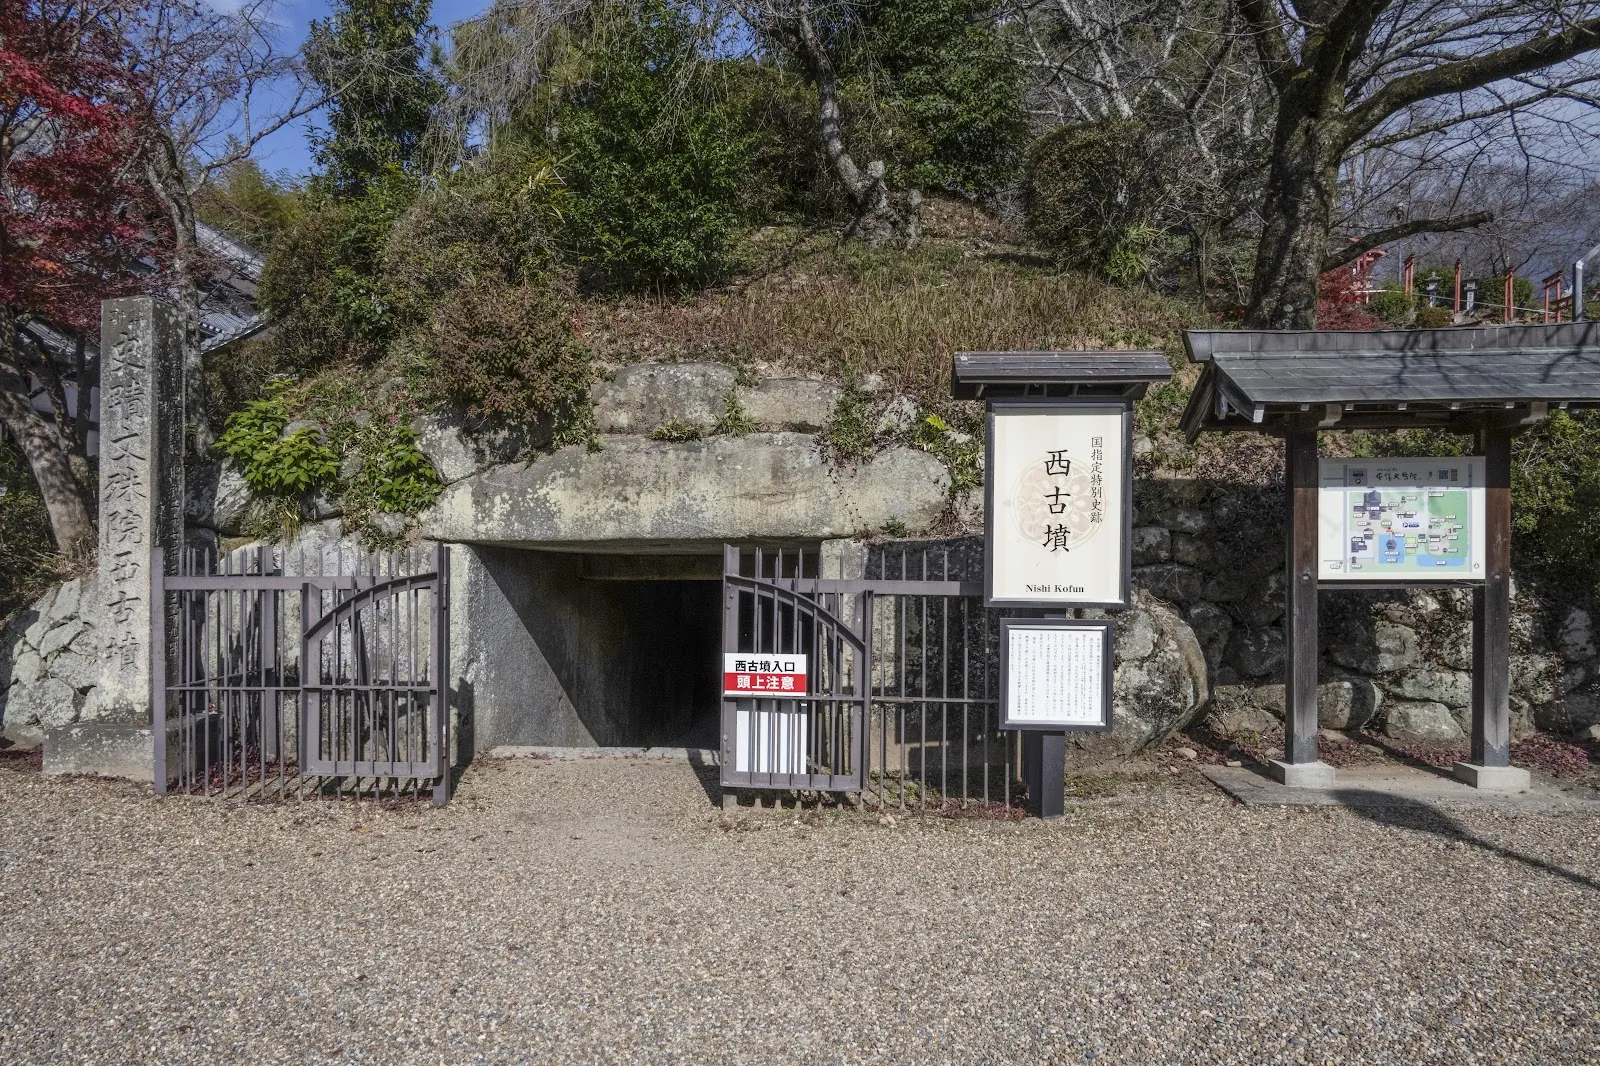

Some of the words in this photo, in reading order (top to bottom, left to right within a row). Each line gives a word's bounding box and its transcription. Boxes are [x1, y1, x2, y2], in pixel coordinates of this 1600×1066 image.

[1090, 436, 1103, 524] 国指定特別史跡
[1042, 448, 1071, 553] 西古墳
[1025, 584, 1051, 593] Nishi
[1054, 584, 1084, 593] Kofun
[735, 660, 796, 672] 西古墳入口
[736, 675, 795, 690] 頭上注意
